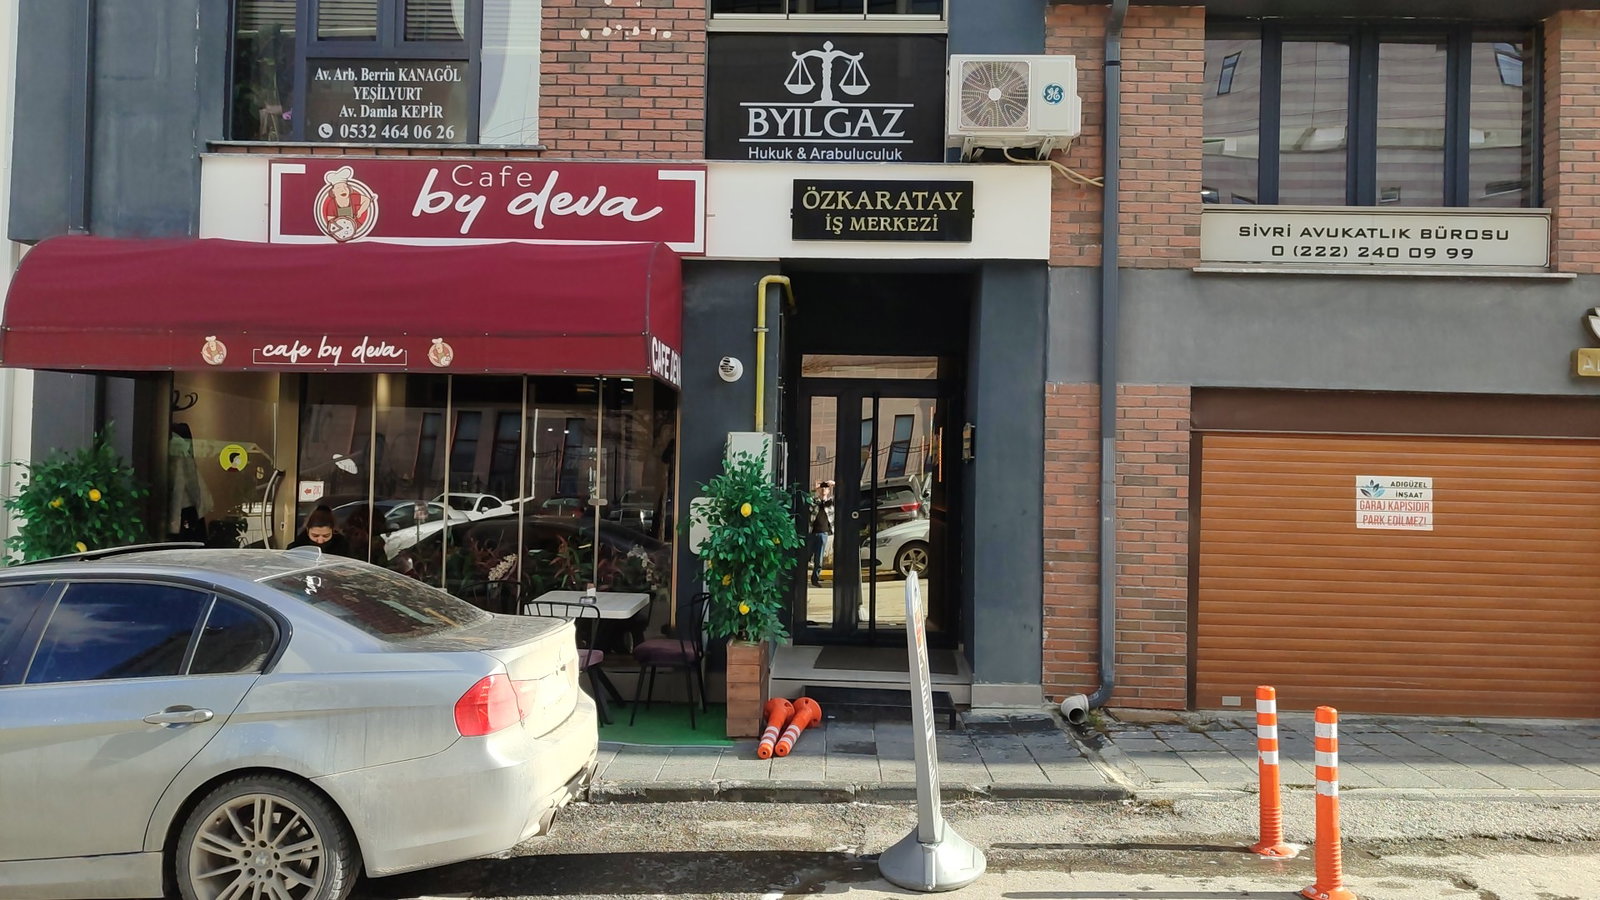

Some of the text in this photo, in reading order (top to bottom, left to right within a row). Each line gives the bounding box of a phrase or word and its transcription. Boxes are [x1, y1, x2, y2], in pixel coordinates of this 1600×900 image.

[315, 65, 461, 81] Av. Arb. Berrin KANAGÖL
[353, 84, 423, 103] YEŞİLYURT
[339, 102, 443, 118] Av. Damla KEPİR
[747, 108, 905, 137] BYILGAZ
[340, 125, 455, 139] 0532 464 06 26
[748, 147, 903, 161] Hukuk & Arabuluculuk
[451, 164, 533, 187] Cafe
[412, 168, 663, 234] by deva
[802, 186, 963, 211] ÖZKARATAY
[825, 213, 938, 234] İŞ MERKEZİ
[1239, 223, 1509, 241] SİVRİ AVUKATLIK BÜROSU
[1271, 245, 1474, 259] 0 (222) 240 09 99
[262, 336, 403, 366] cafe by deva
[652, 336, 671, 380] CAFE
[1390, 480, 1428, 489] ADIGÜZEL
[1395, 490, 1424, 499] İNŞAAT
[1360, 500, 1430, 512] GARAJ KAPISIDIR
[1363, 515, 1385, 526] PARK
